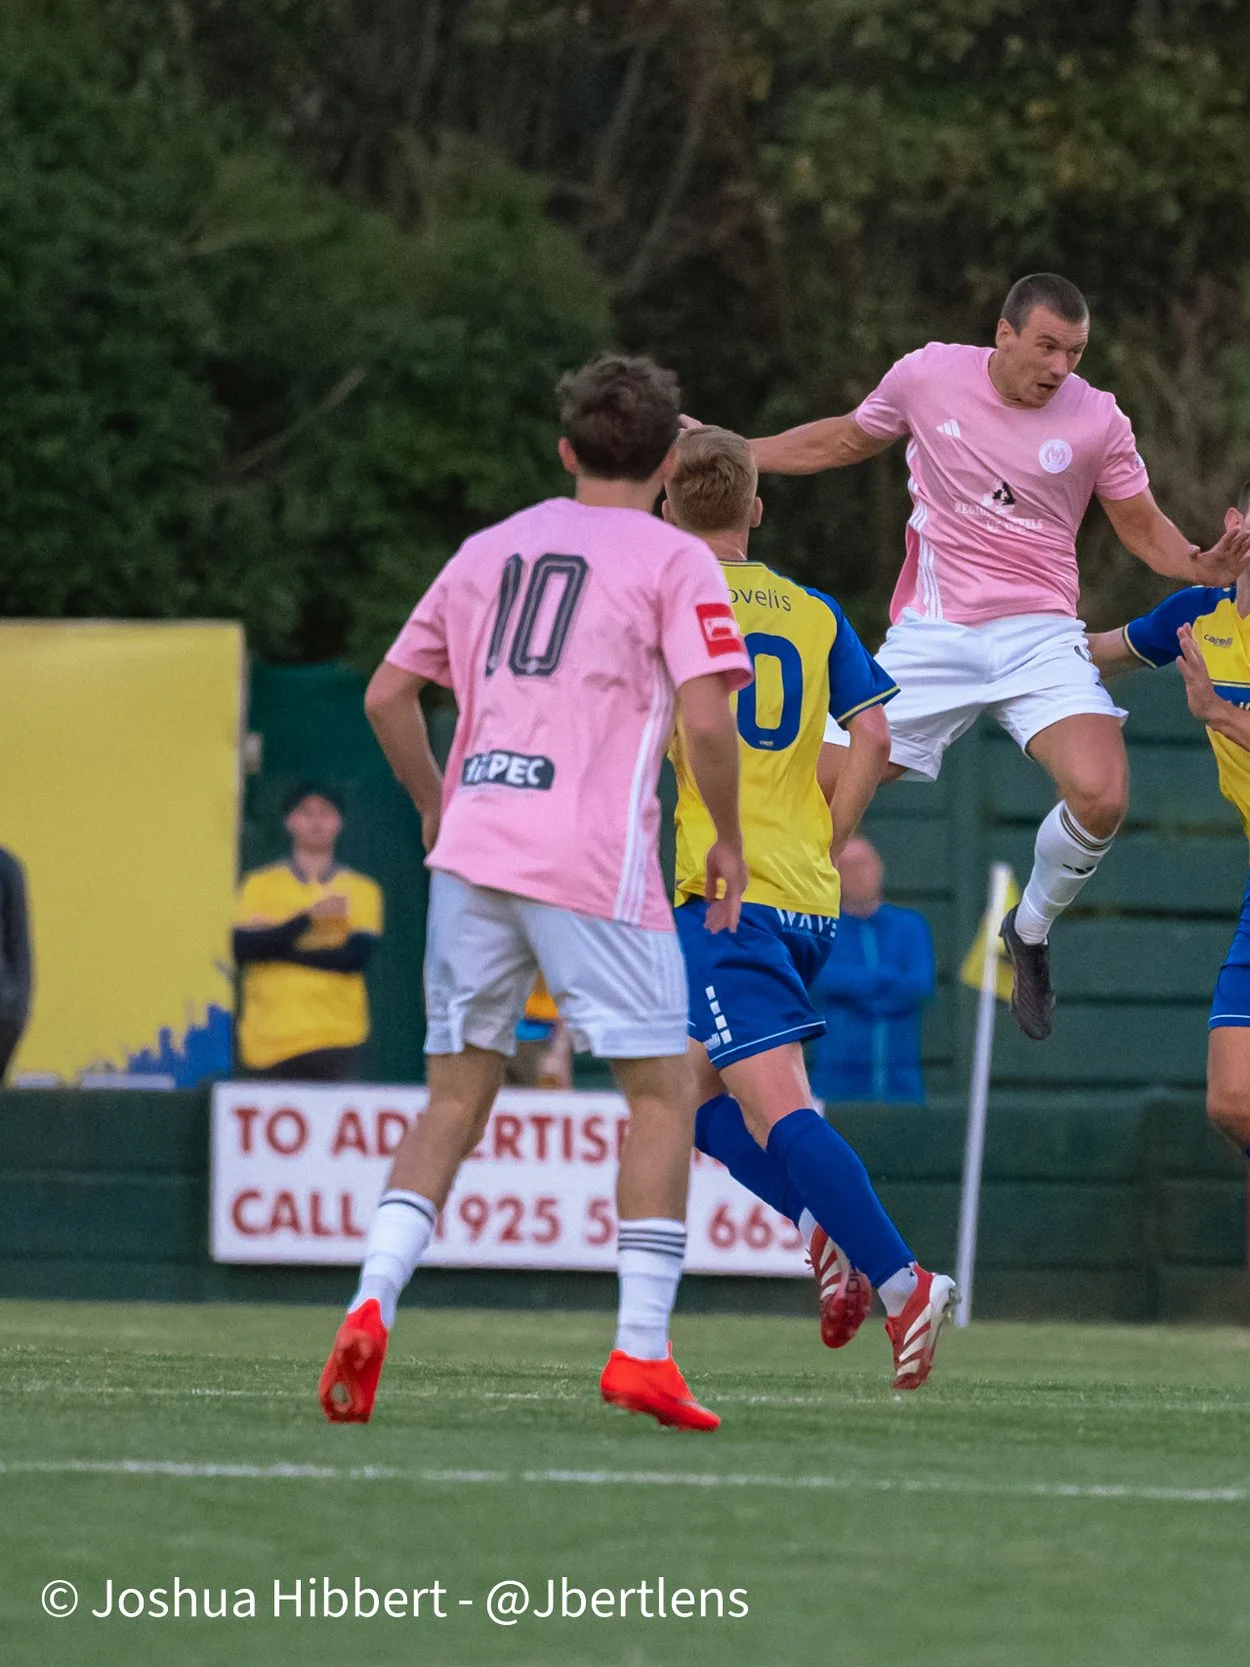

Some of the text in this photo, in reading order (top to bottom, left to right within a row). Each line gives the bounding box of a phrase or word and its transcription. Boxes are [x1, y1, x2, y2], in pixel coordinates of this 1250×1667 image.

[486, 553, 589, 676] 10
[728, 588, 792, 612] ovelis
[234, 1107, 629, 1163] TO ADRTIS
[231, 1190, 365, 1239] CALL
